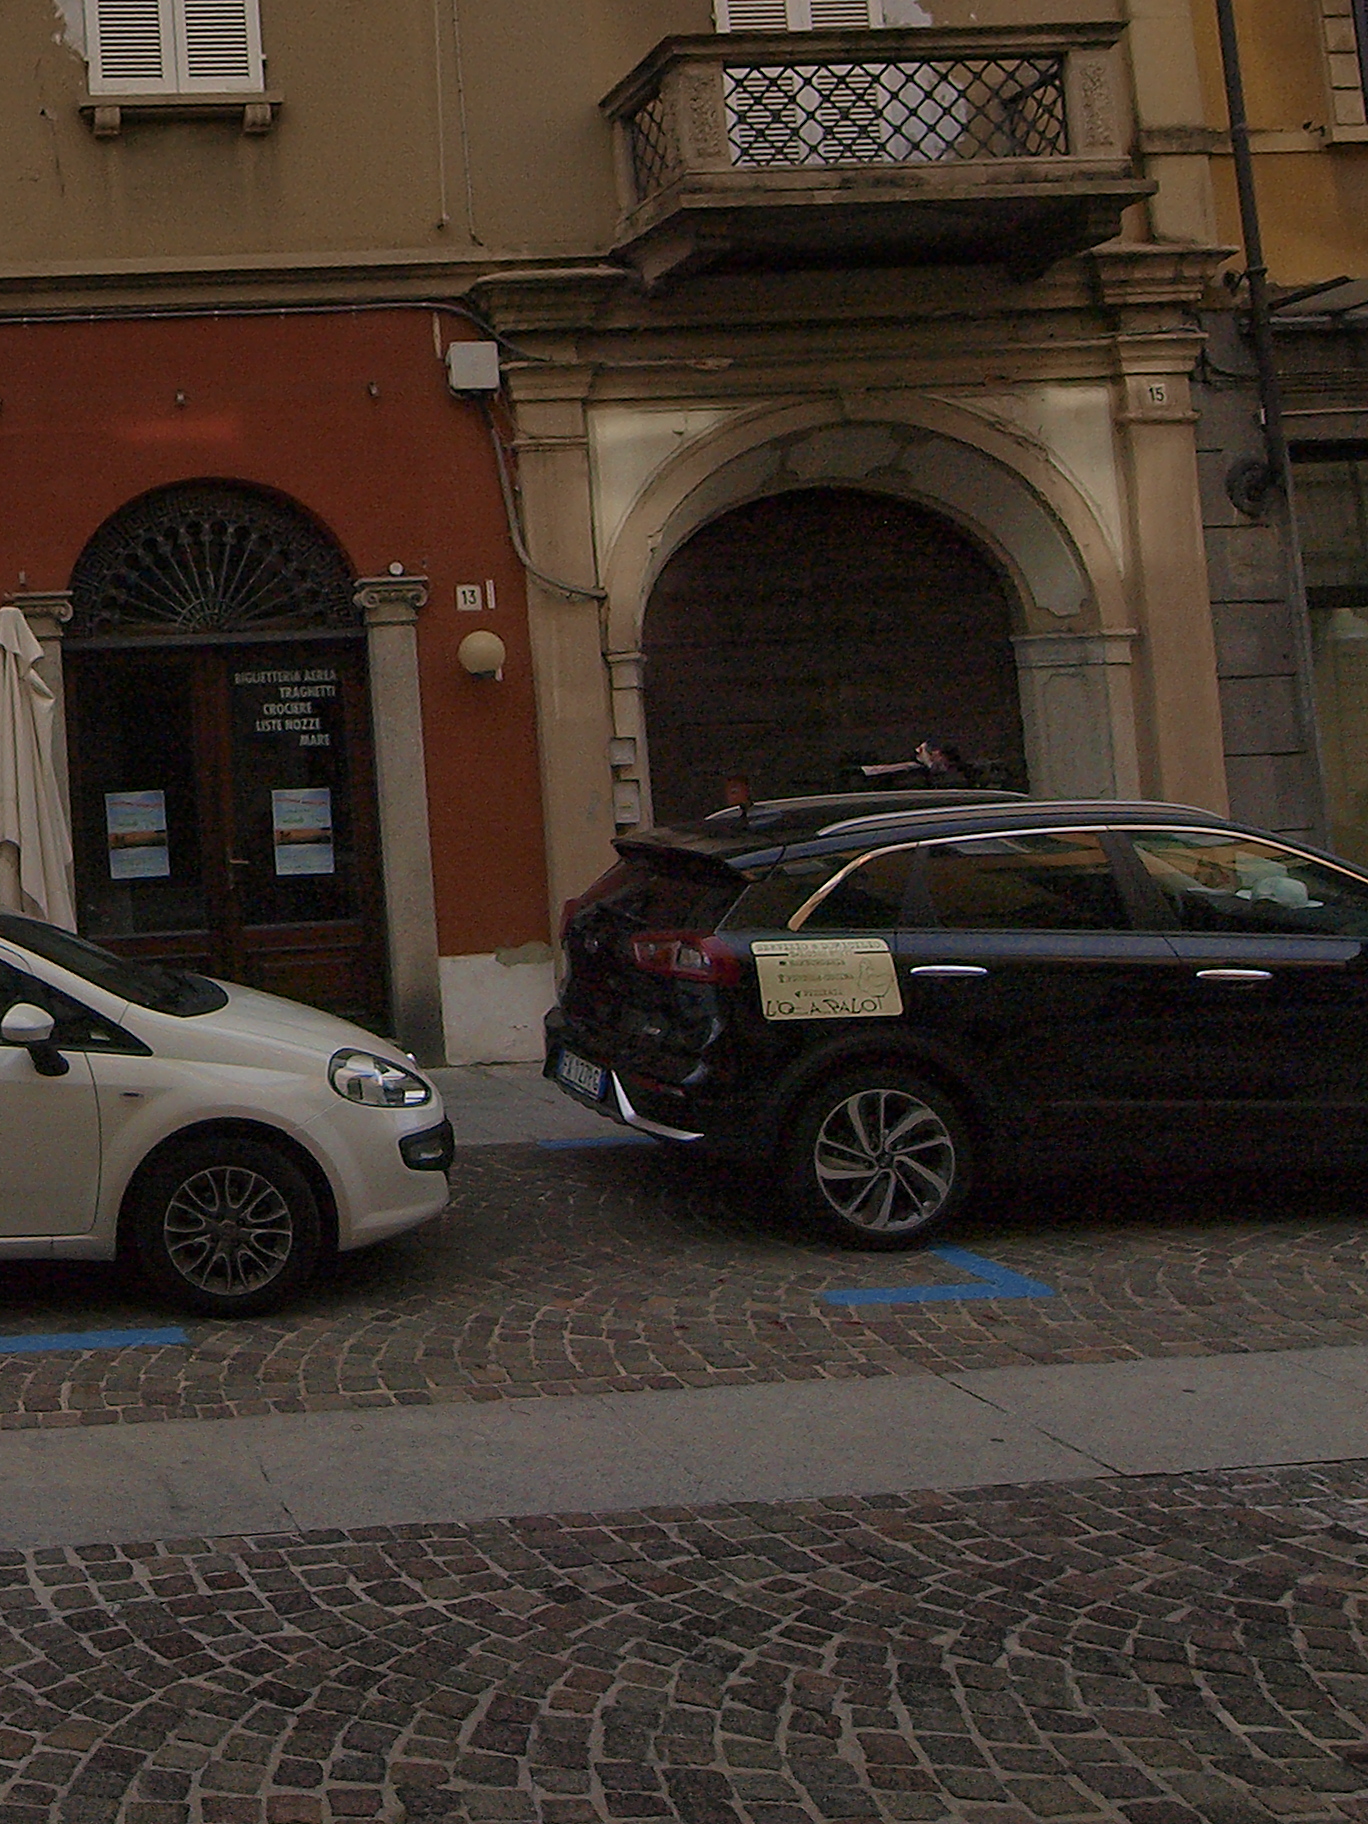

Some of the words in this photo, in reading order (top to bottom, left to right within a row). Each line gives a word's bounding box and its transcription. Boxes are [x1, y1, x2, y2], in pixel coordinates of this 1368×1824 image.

[1149, 386, 1165, 402] 15
[462, 589, 477, 605] 13
[234, 670, 301, 685] BIGLIETTERIA
[279, 685, 335, 698] TRAGHETTI
[263, 701, 312, 715] CROCIERE
[255, 719, 282, 732] LISTE
[285, 717, 320, 731] NOZZE
[299, 733, 330, 747] MARE
